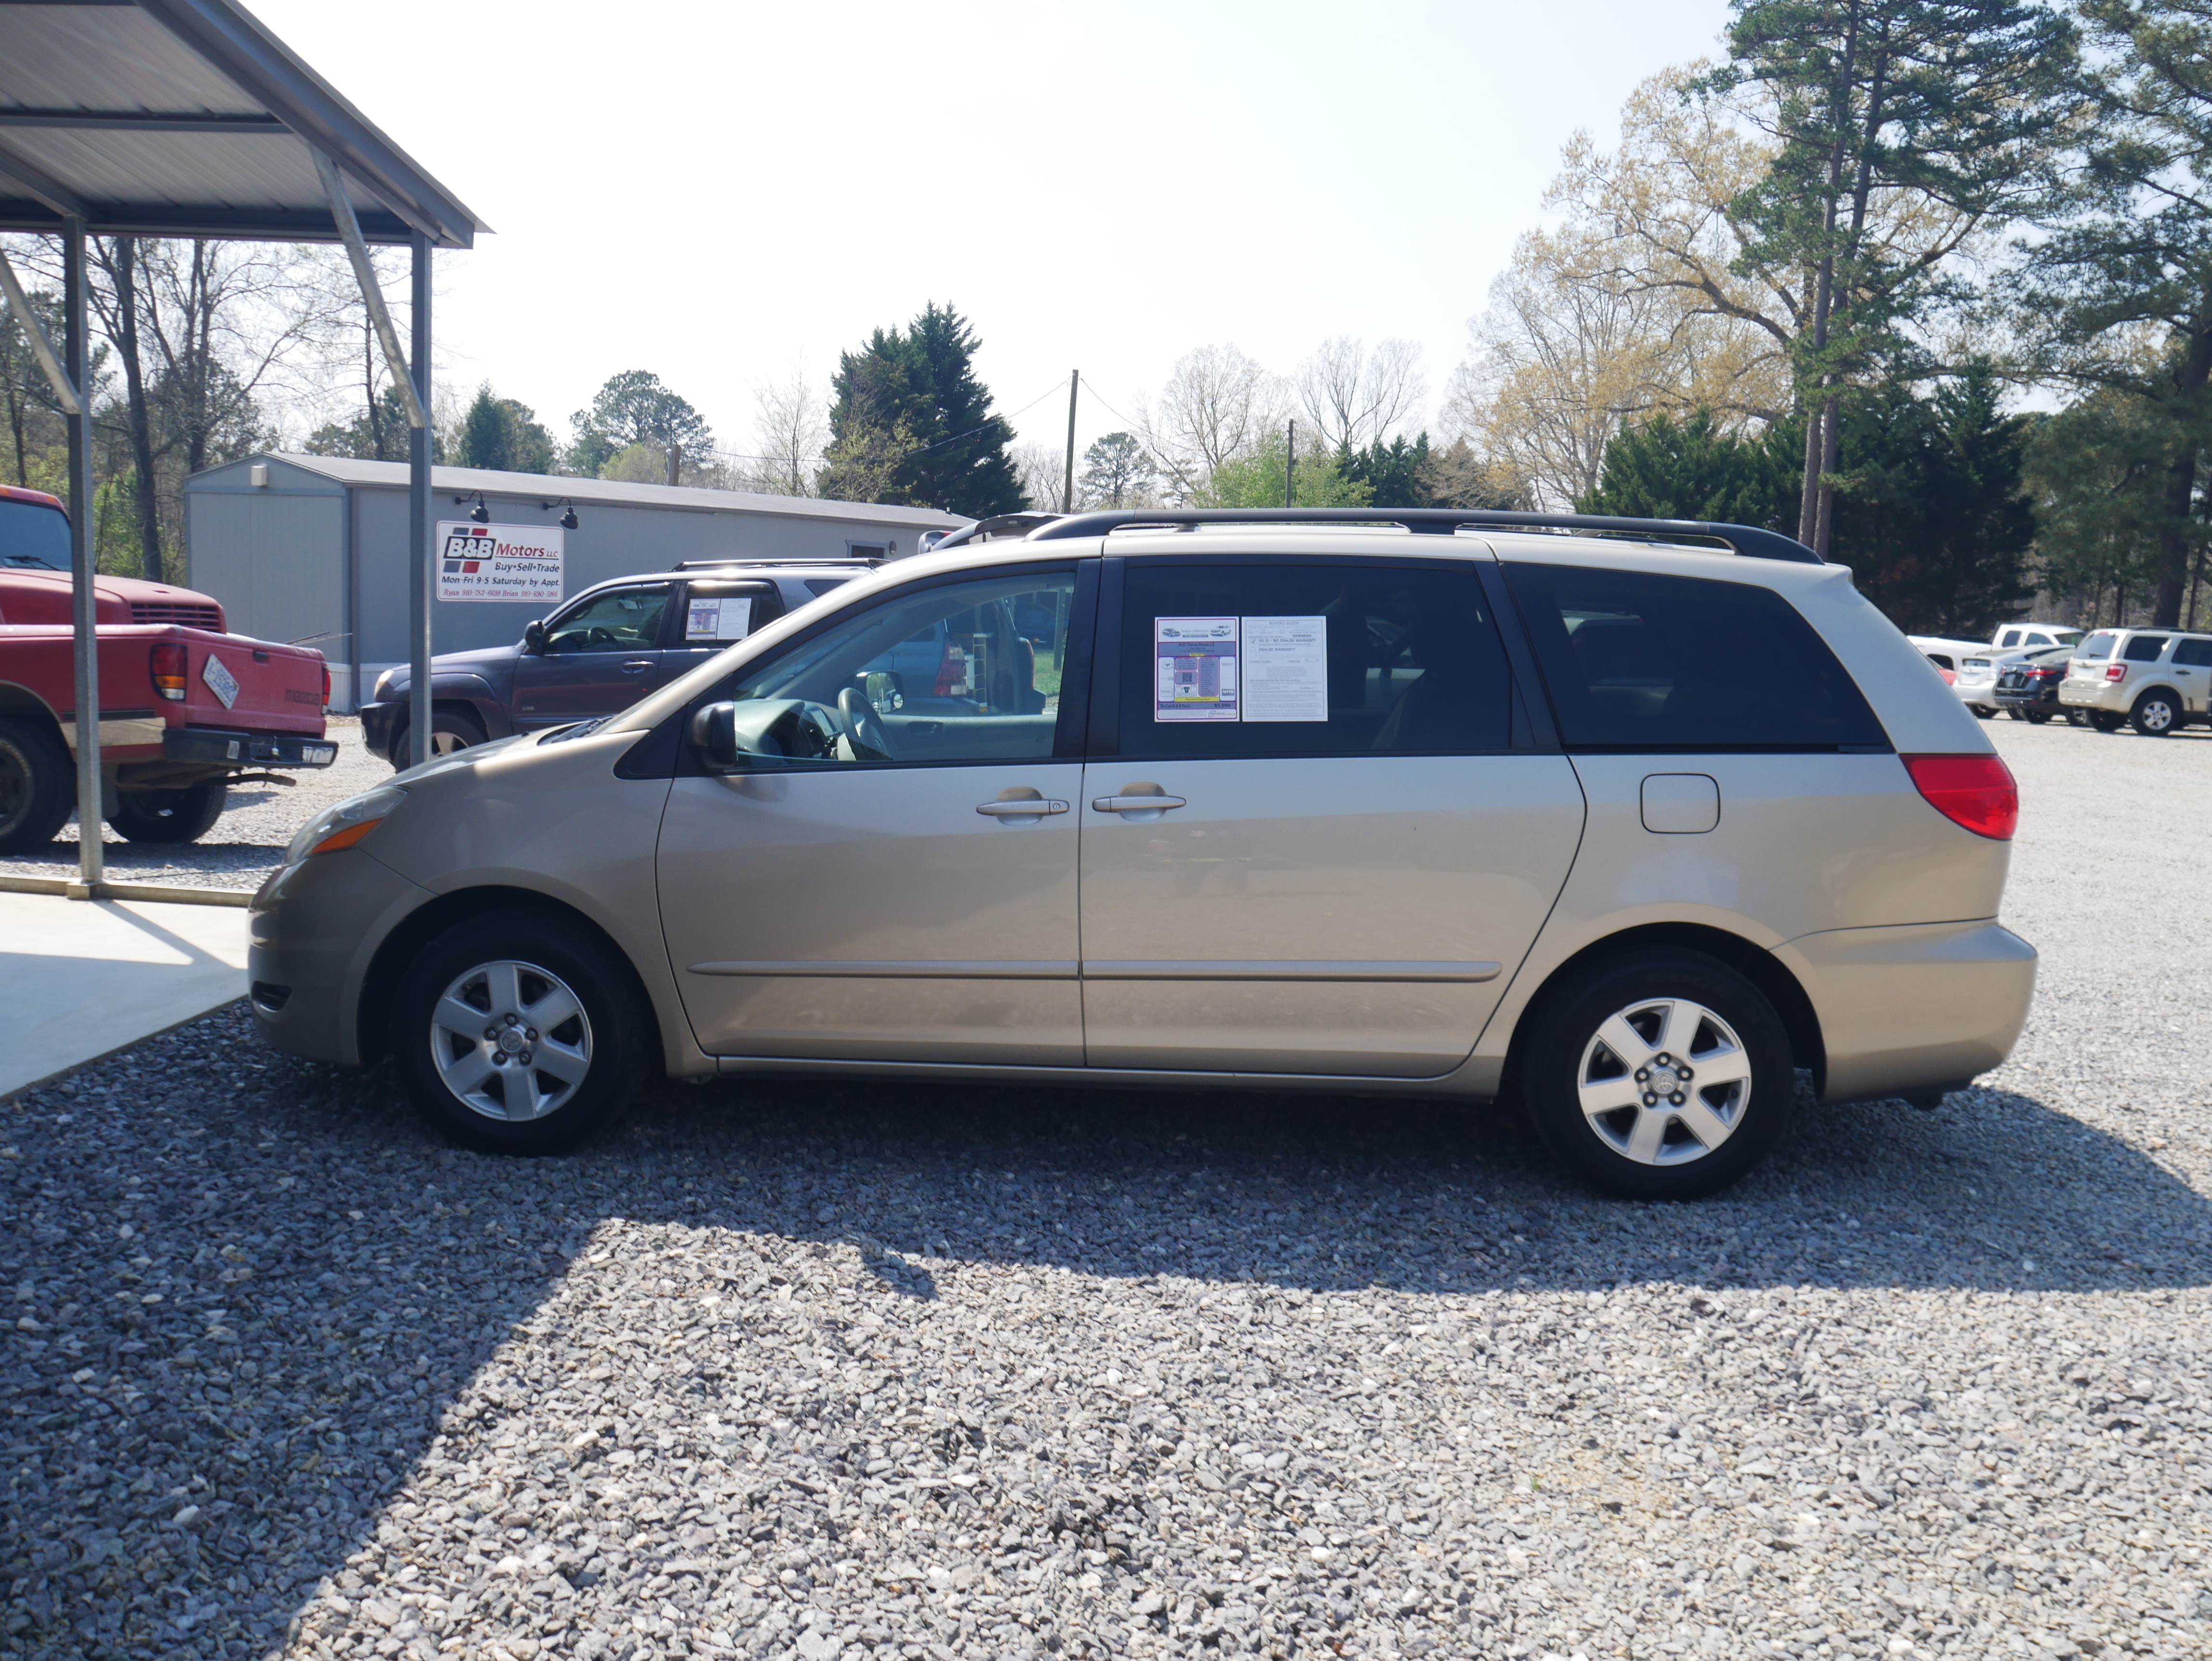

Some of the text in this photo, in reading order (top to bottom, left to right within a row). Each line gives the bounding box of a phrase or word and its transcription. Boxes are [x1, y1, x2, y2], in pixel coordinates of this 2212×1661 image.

[447, 537, 493, 558] B&B
[496, 543, 545, 557] Motors
[492, 577, 527, 586] Saturday
[529, 578, 539, 587] by
[541, 579, 560, 587] Appt.
[443, 588, 460, 597] Ryan
